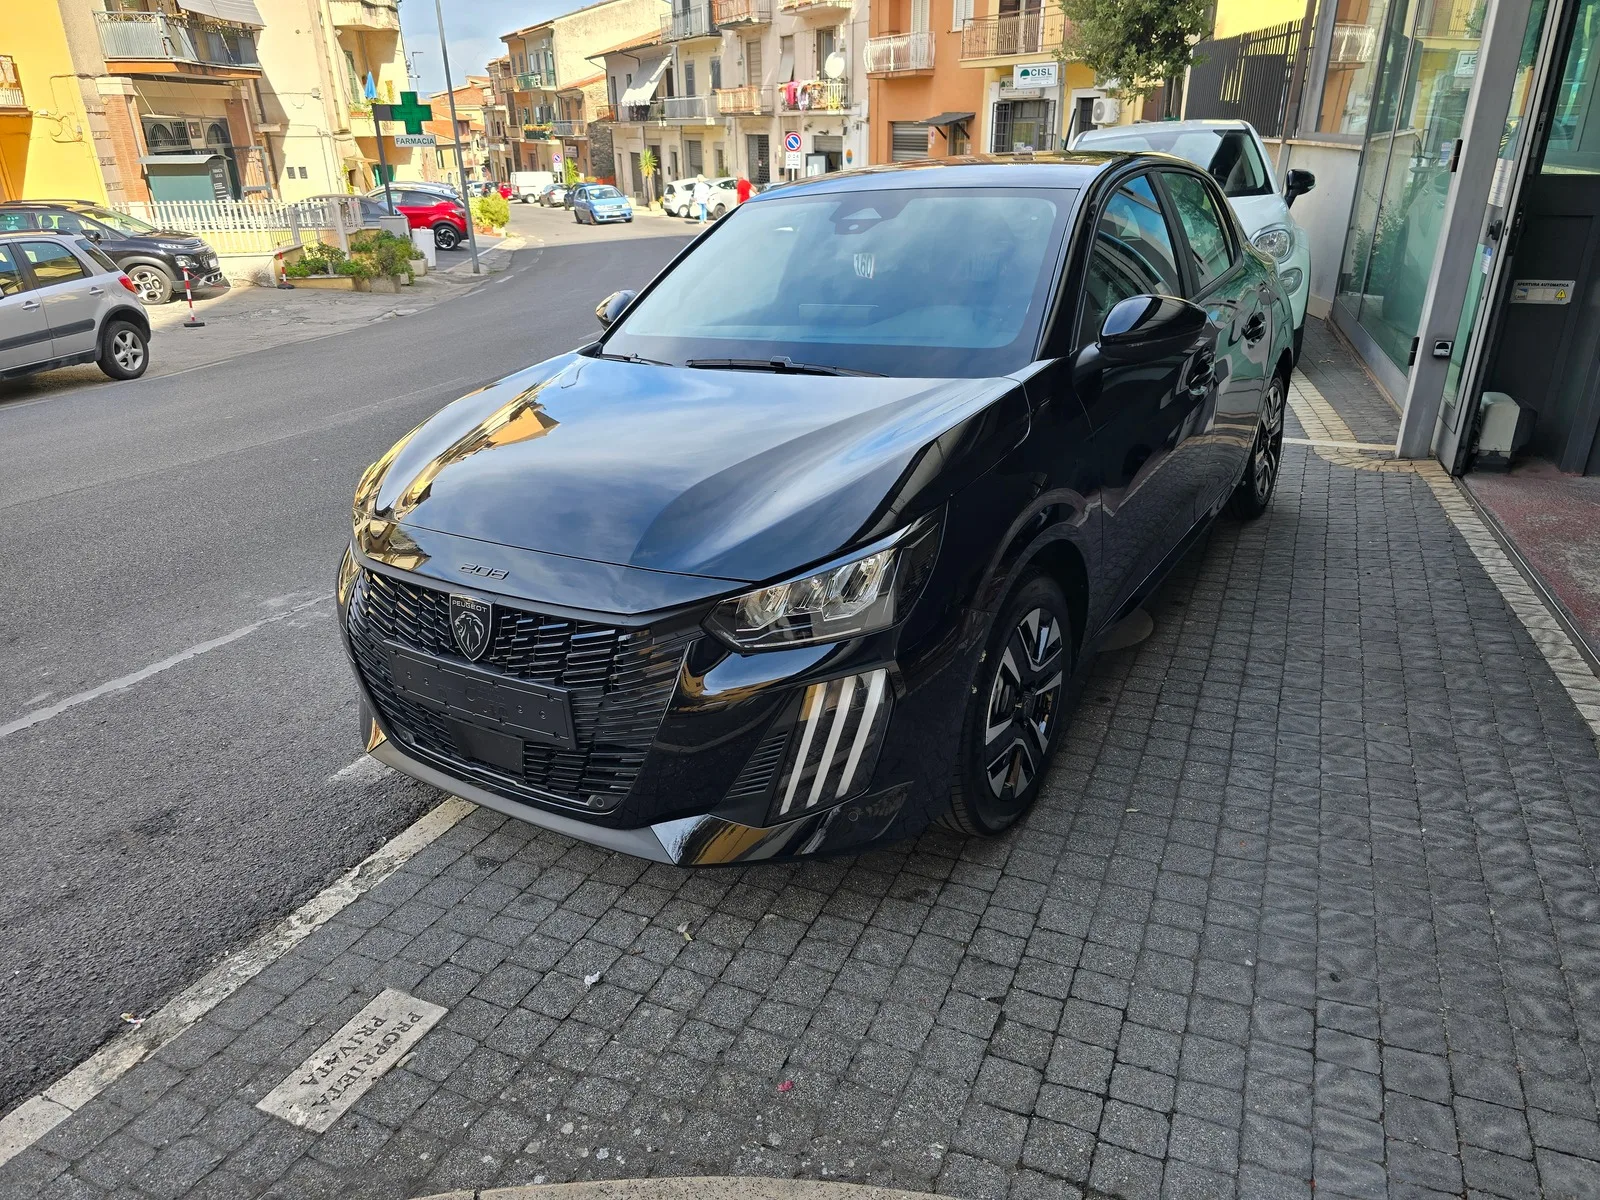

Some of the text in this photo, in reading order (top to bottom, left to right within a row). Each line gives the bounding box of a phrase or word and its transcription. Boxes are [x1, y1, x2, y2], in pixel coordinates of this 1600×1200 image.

[1030, 68, 1053, 77] CISL
[395, 137, 435, 145] FARMACIA
[856, 253, 873, 278] 160
[459, 563, 510, 580] 208
[452, 600, 487, 613] PEUGEOT
[299, 1015, 388, 1086] PRIVATA
